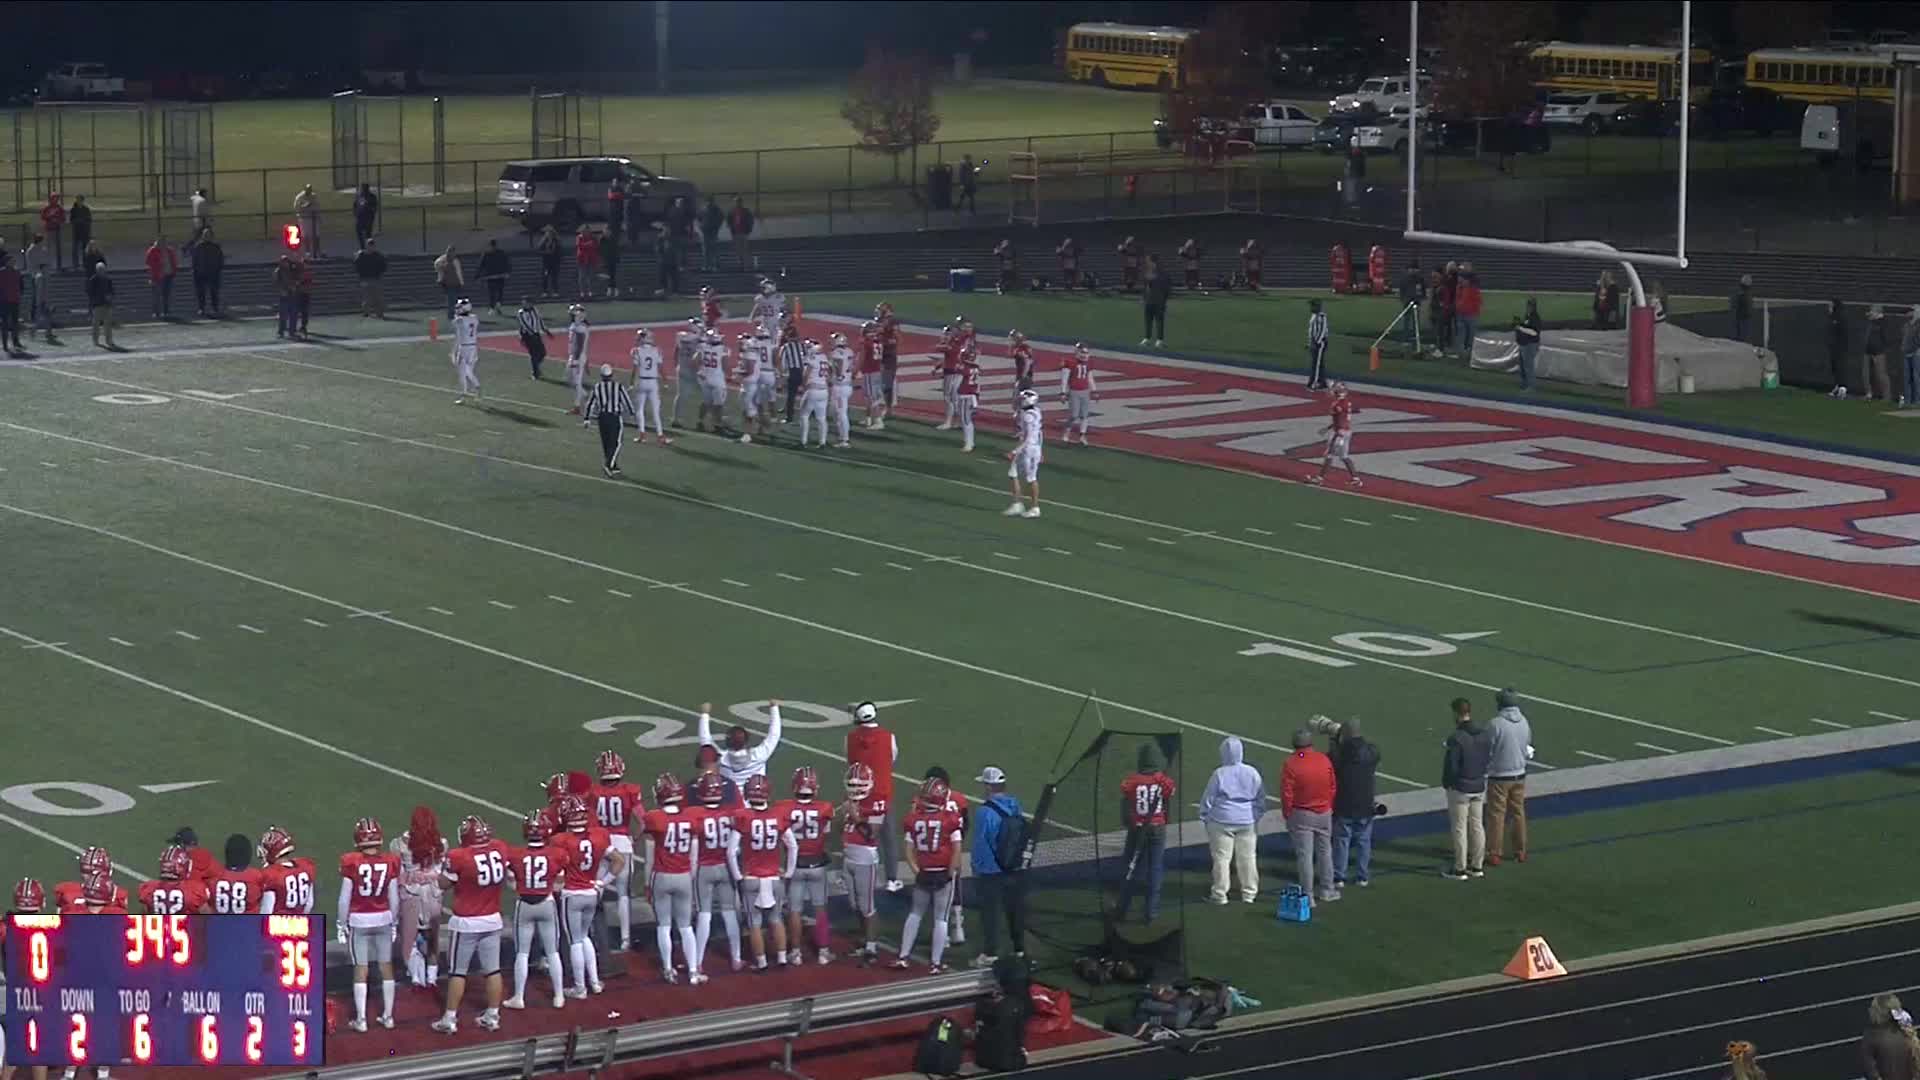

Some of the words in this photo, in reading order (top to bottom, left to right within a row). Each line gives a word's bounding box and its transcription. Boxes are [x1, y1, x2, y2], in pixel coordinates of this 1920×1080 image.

[287, 225, 300, 245] 2
[644, 356, 653, 370] 3
[1236, 631, 1459, 667] 10
[581, 700, 862, 749] 20
[596, 796, 623, 827] 40
[790, 810, 819, 840] 25
[663, 822, 691, 853] 45
[703, 816, 731, 850] 96
[750, 819, 778, 851] 95
[914, 820, 942, 852] 27
[473, 850, 505, 886] 56
[522, 854, 548, 889] 12
[579, 839, 593, 872] 3
[285, 871, 311, 909] 86
[357, 863, 388, 896] 37
[215, 880, 247, 914] 68
[1529, 942, 1554, 973] 20
